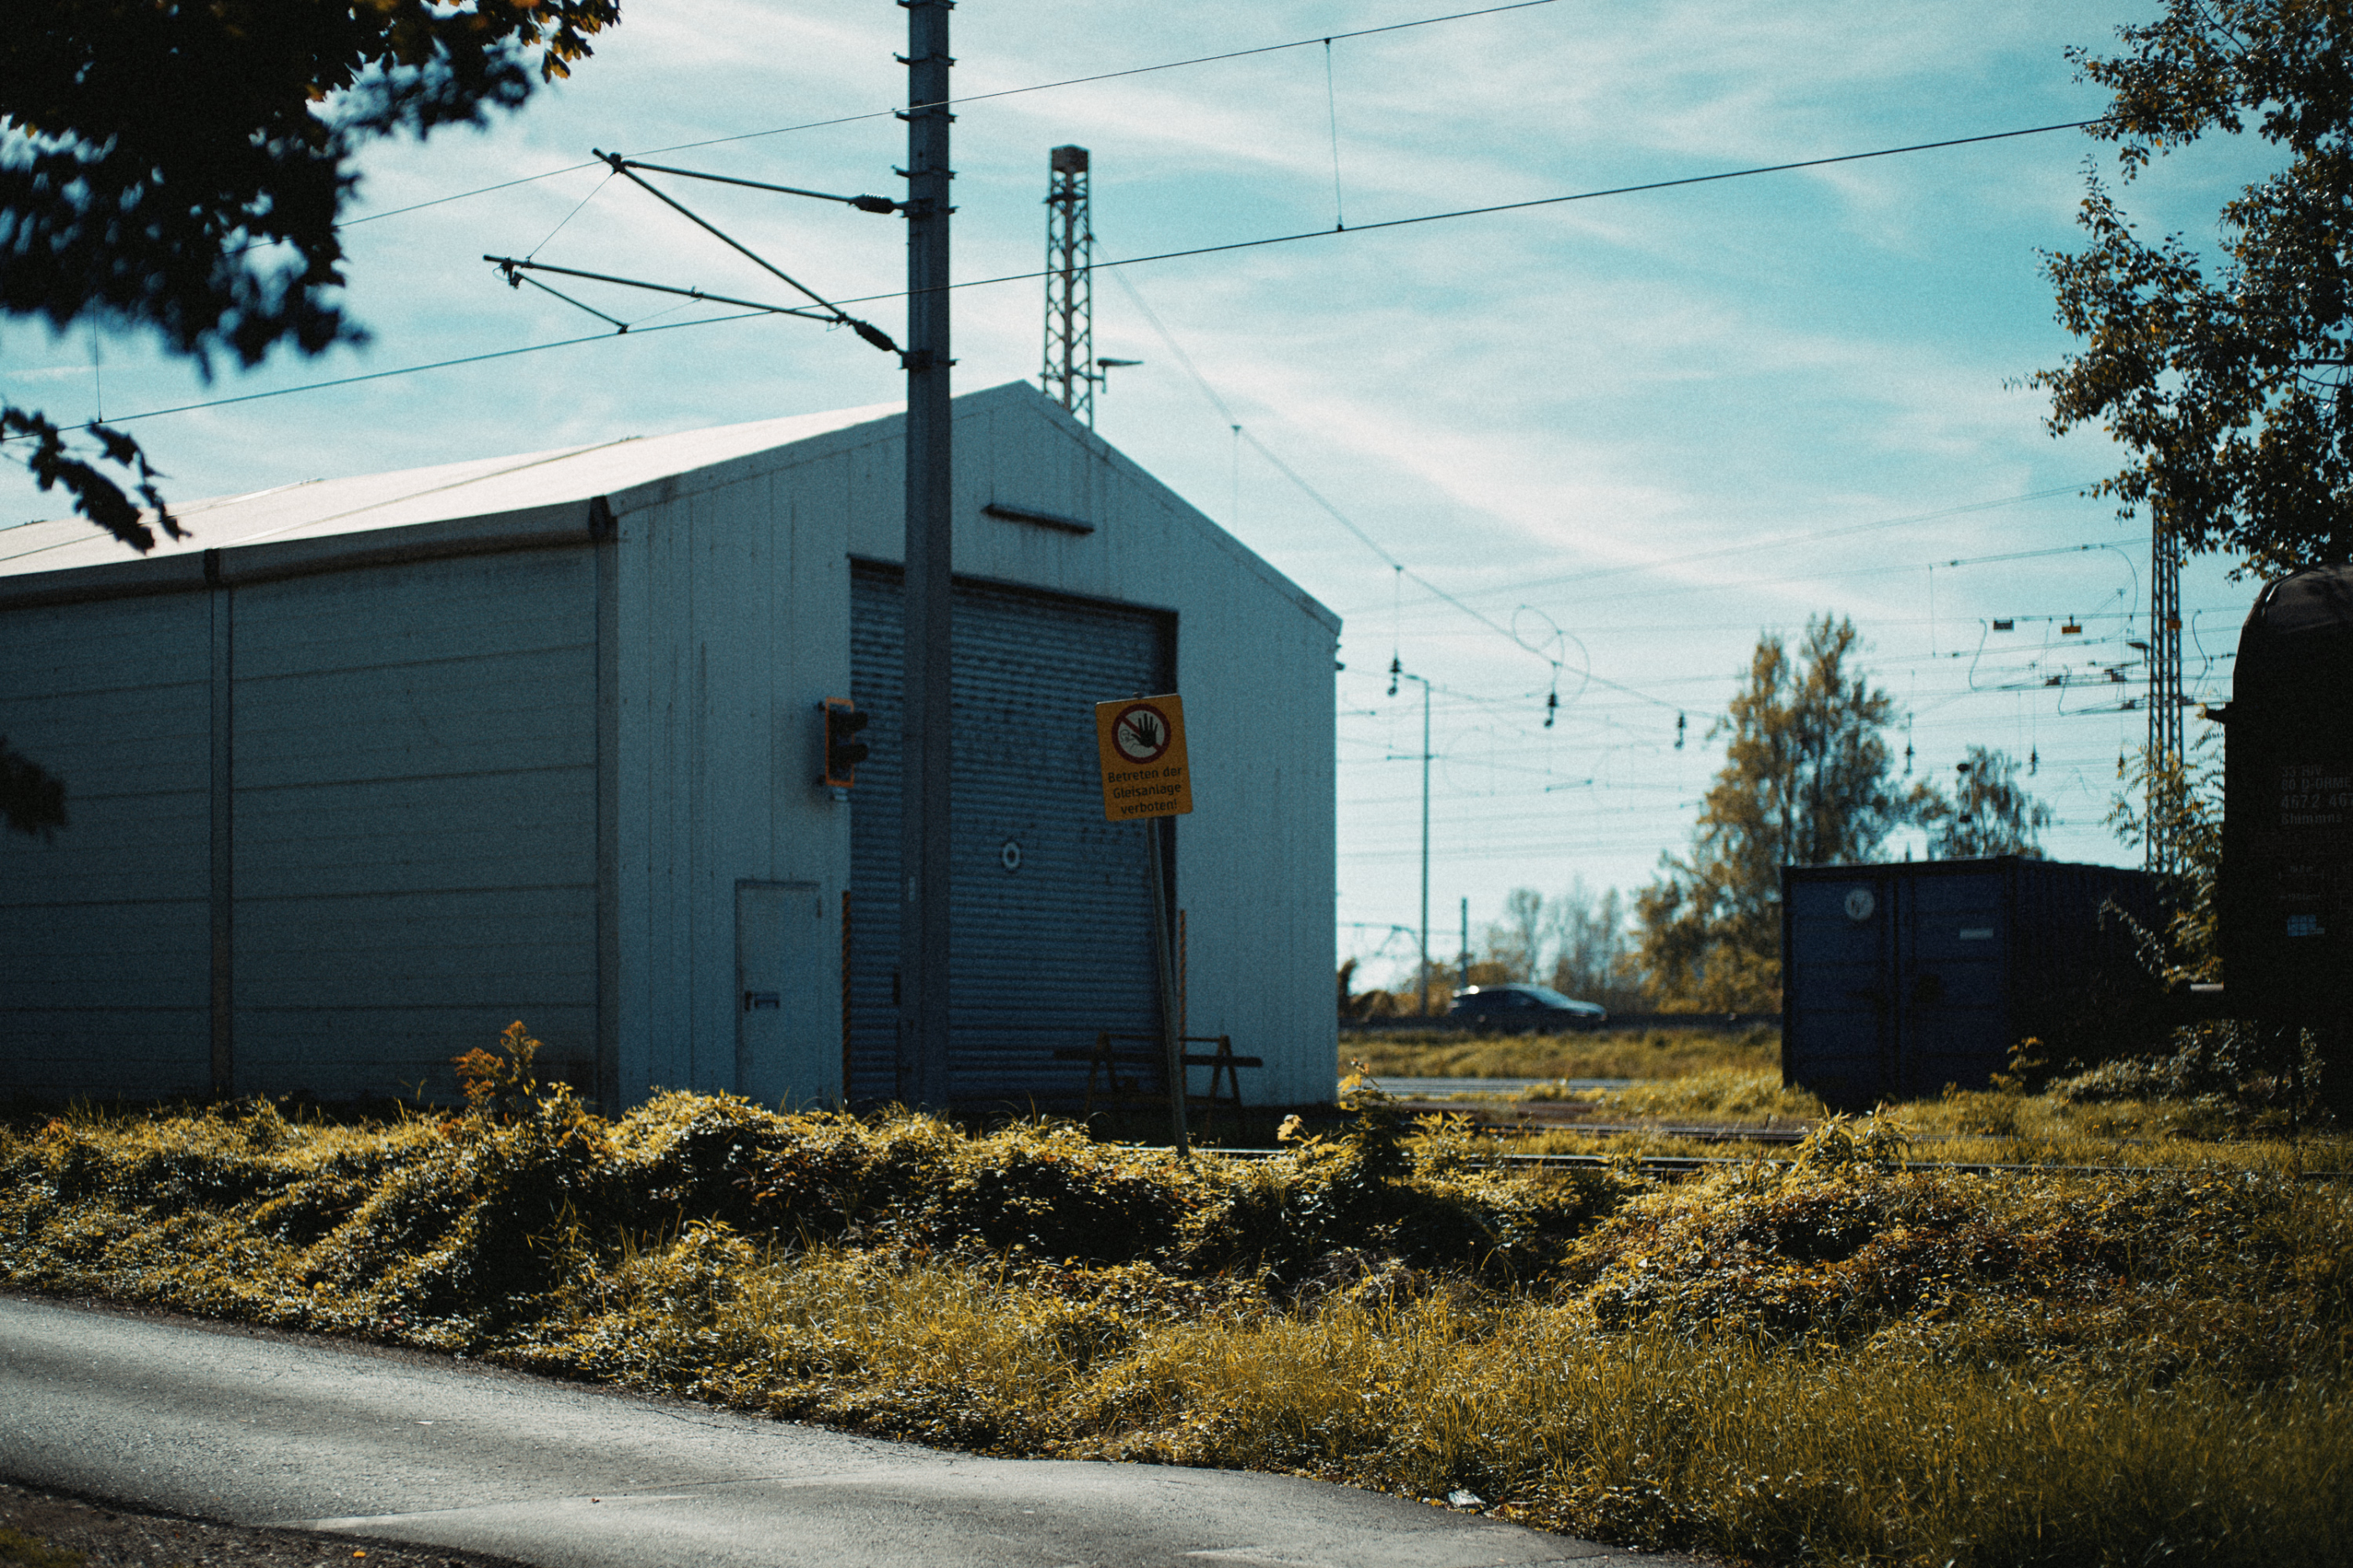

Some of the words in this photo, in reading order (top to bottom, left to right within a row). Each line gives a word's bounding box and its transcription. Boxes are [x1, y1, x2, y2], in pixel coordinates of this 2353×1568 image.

[1108, 770, 1159, 782] Betreten
[1163, 766, 1182, 777] der
[1113, 784, 1181, 798] Gleisanlage
[2282, 778, 2297, 792] 80
[1120, 798, 1177, 814] verboten!
